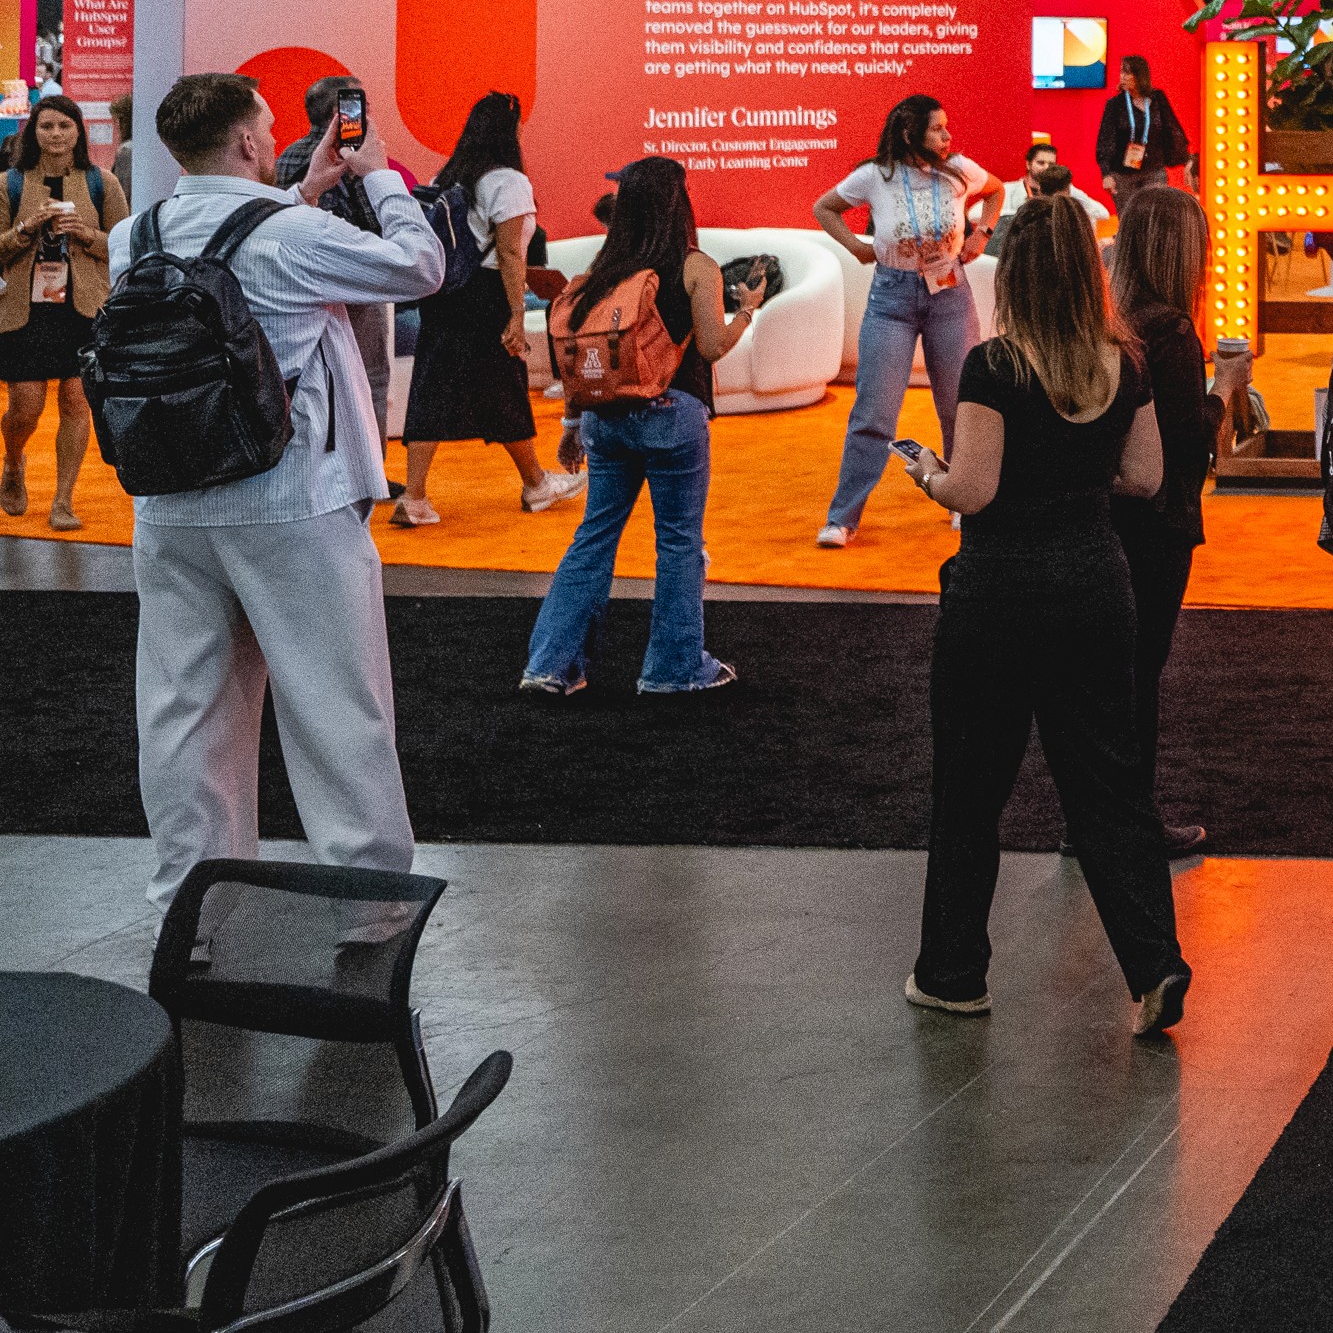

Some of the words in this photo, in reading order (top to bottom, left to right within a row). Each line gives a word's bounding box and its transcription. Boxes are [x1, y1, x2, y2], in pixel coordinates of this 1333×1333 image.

[109, 0, 129, 10] Are
[645, 0, 694, 14] teams
[697, 1, 763, 18] together
[766, 3, 785, 15] on
[789, 2, 856, 18] HubSpot,
[859, 2, 879, 16] it's
[882, 4, 957, 19] completely
[74, 11, 128, 23] HubSpot
[88, 24, 116, 35] User
[645, 20, 713, 34] removed
[717, 20, 742, 34] the
[745, 20, 823, 38] guesswork
[827, 21, 848, 35] for
[851, 23, 875, 35] our
[878, 21, 933, 37] leaders,
[935, 22, 979, 39] giving
[76, 36, 128, 50] Groups?
[645, 40, 685, 54] them
[689, 40, 752, 57] visibility
[755, 41, 784, 54] and
[788, 41, 867, 55] confidence
[870, 42, 899, 54] that
[902, 44, 972, 55] customers
[644, 62, 671, 75] are
[674, 60, 731, 78] getting
[734, 61, 772, 74] what
[775, 60, 808, 77] they
[812, 61, 851, 75] need,
[644, 107, 727, 129] Jennifer
[731, 106, 837, 129] Cummings
[661, 140, 709, 153] Director,
[712, 139, 767, 151] Customer
[769, 138, 837, 152] Engagement
[688, 157, 718, 172] Early
[721, 156, 771, 171] Learning
[773, 155, 809, 168] Center
